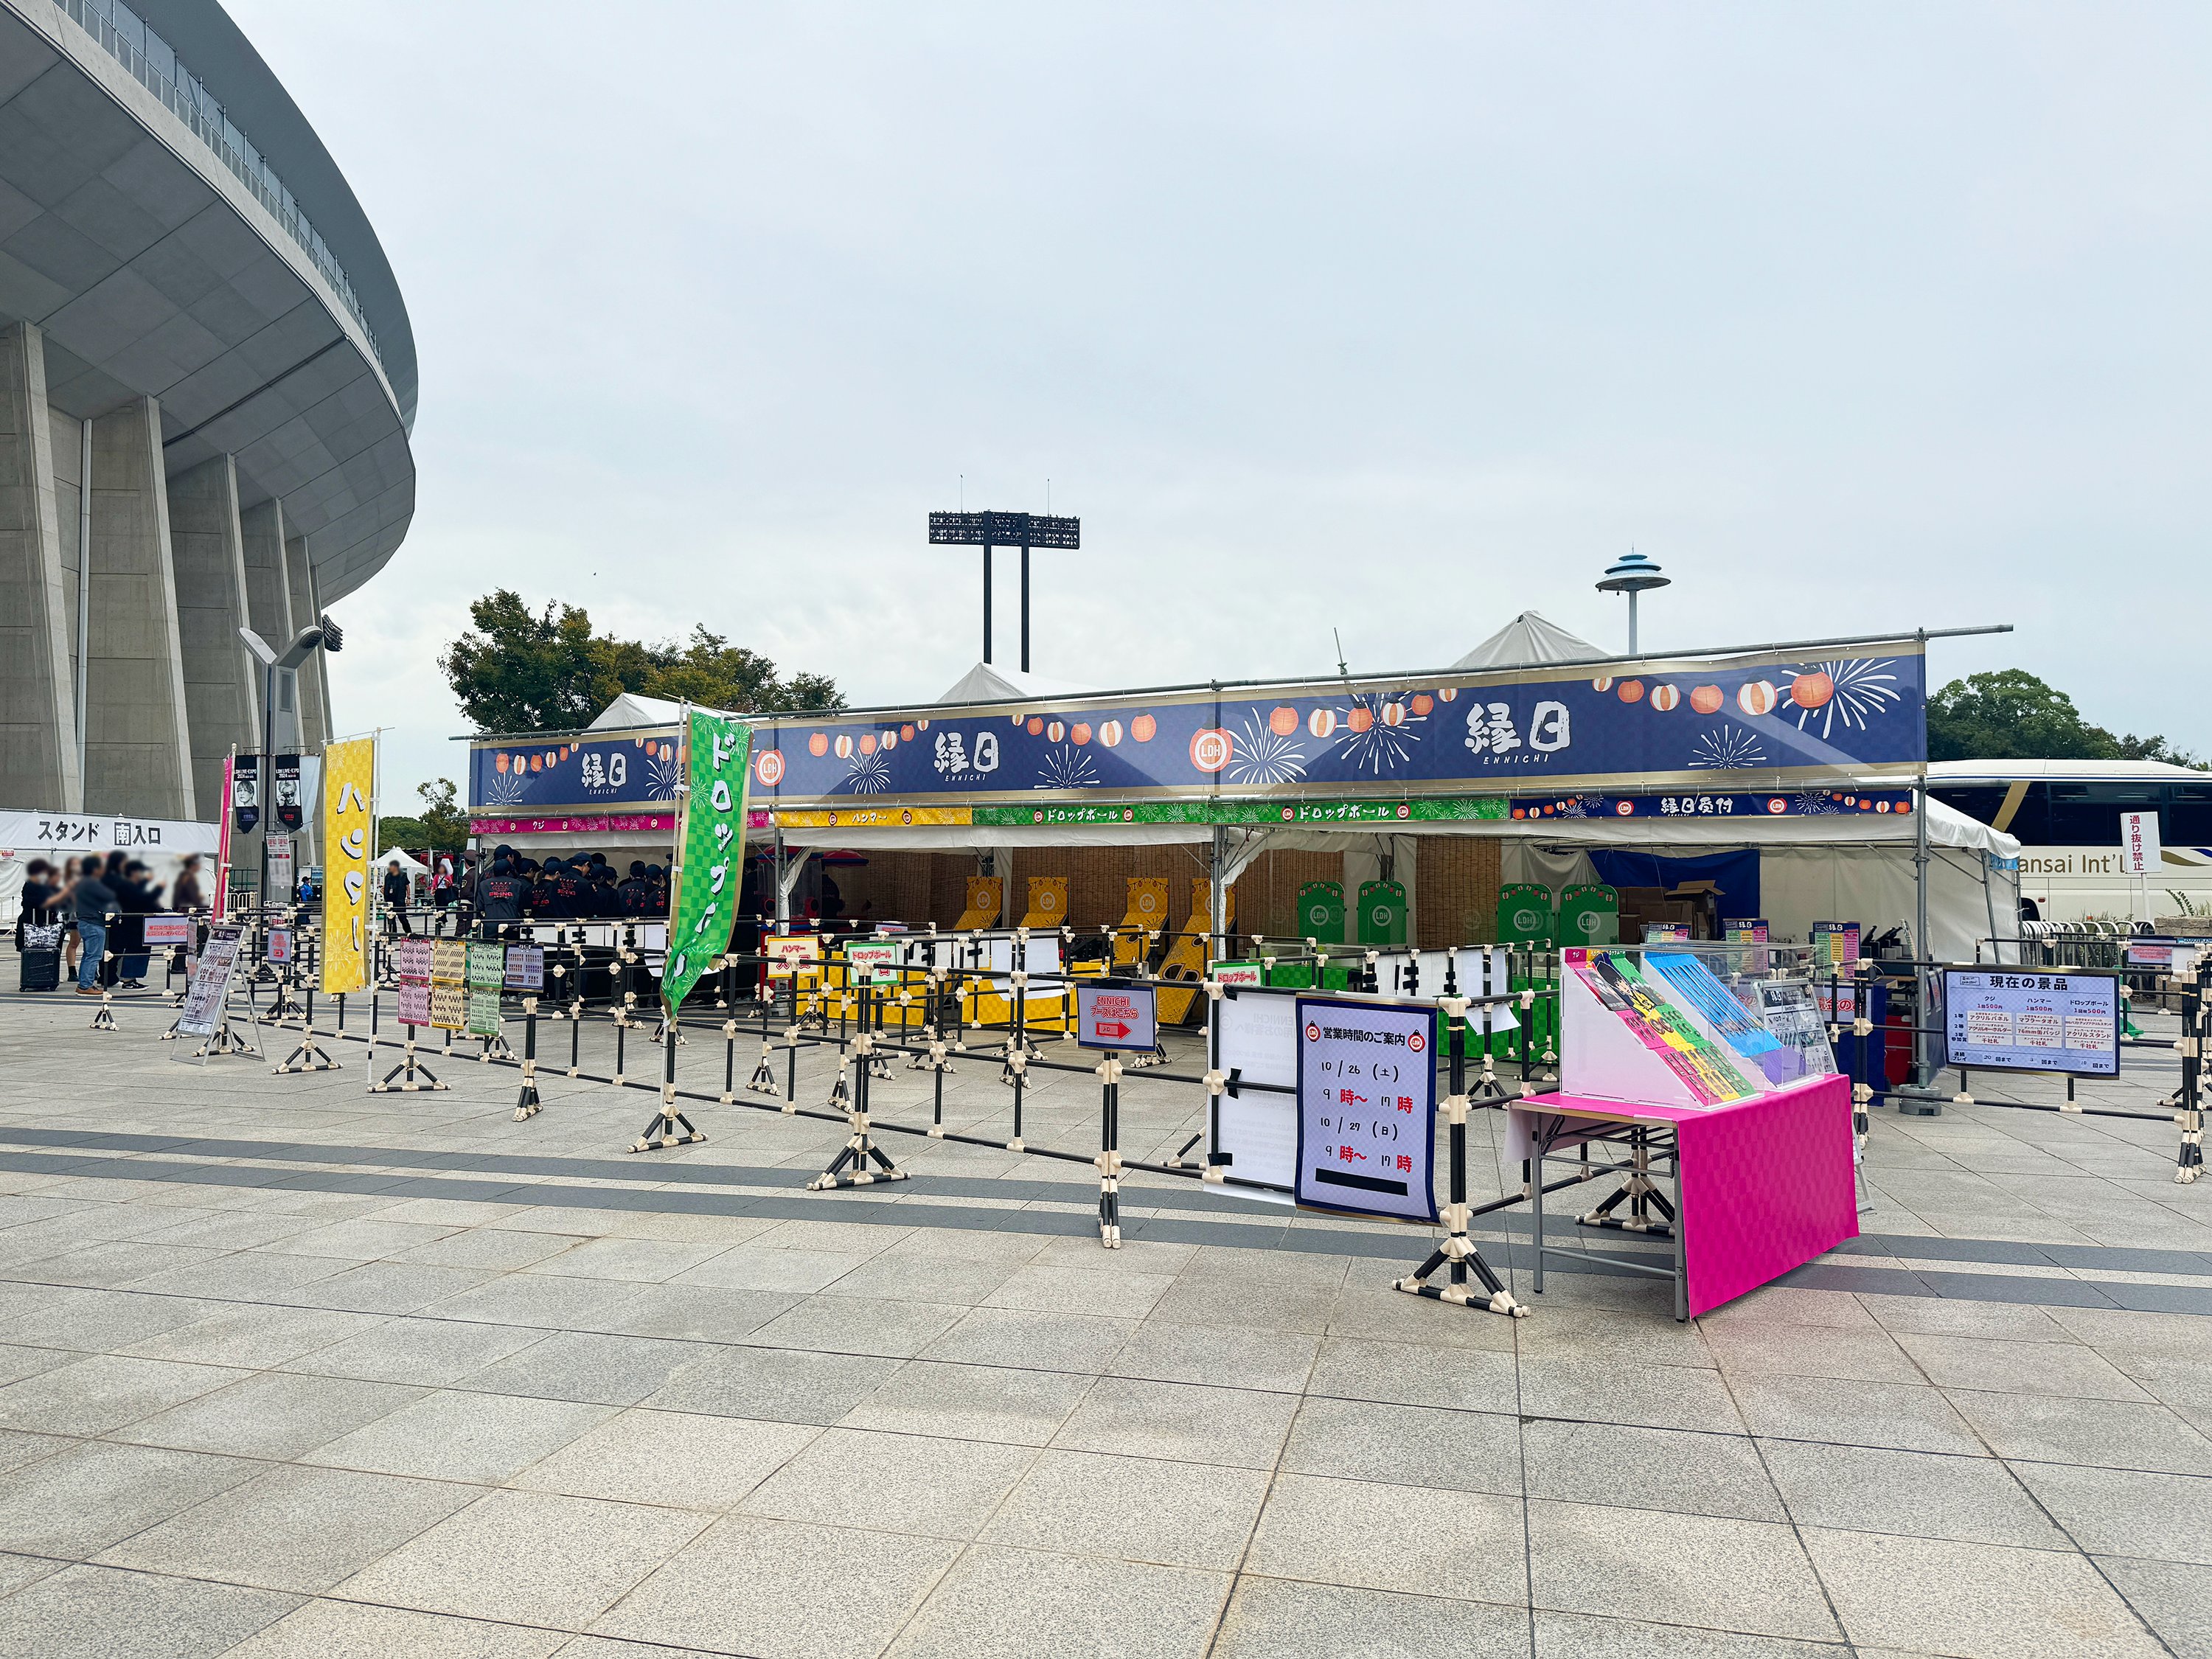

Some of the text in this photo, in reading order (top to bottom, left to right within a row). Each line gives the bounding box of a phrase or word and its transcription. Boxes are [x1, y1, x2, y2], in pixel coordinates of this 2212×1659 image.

[1464, 700, 1571, 754] 縁日
[933, 731, 999, 773] 縁日
[1201, 745, 1221, 757] LDH
[1483, 754, 1549, 765] ENNICHI
[582, 753, 626, 788] 縁日
[763, 762, 777, 773] LDH
[945, 774, 987, 782] ENNICHI
[1660, 796, 1733, 814] 縁日受付
[852, 812, 888, 823] ハンマー
[1048, 808, 1119, 821] ドロップボール
[1299, 804, 1390, 820] ドロップボール
[532, 821, 545, 830] クジ
[38, 821, 161, 846] スタンド 南入口
[2129, 815, 2144, 871] 通り抜け禁止
[2020, 854, 2073, 873] ansai
[781, 945, 807, 953] ハンマー
[852, 950, 892, 960] ドロップボール
[1217, 971, 1257, 983] ドロップボール
[1990, 975, 2067, 991] 現在の景品
[1096, 995, 1130, 1007] ENNICHI
[1091, 1005, 1139, 1020] ブースはこちら
[1323, 1026, 1405, 1046] 営業時間のご案内
[2067, 1031, 2112, 1039] アクリルスタンド
